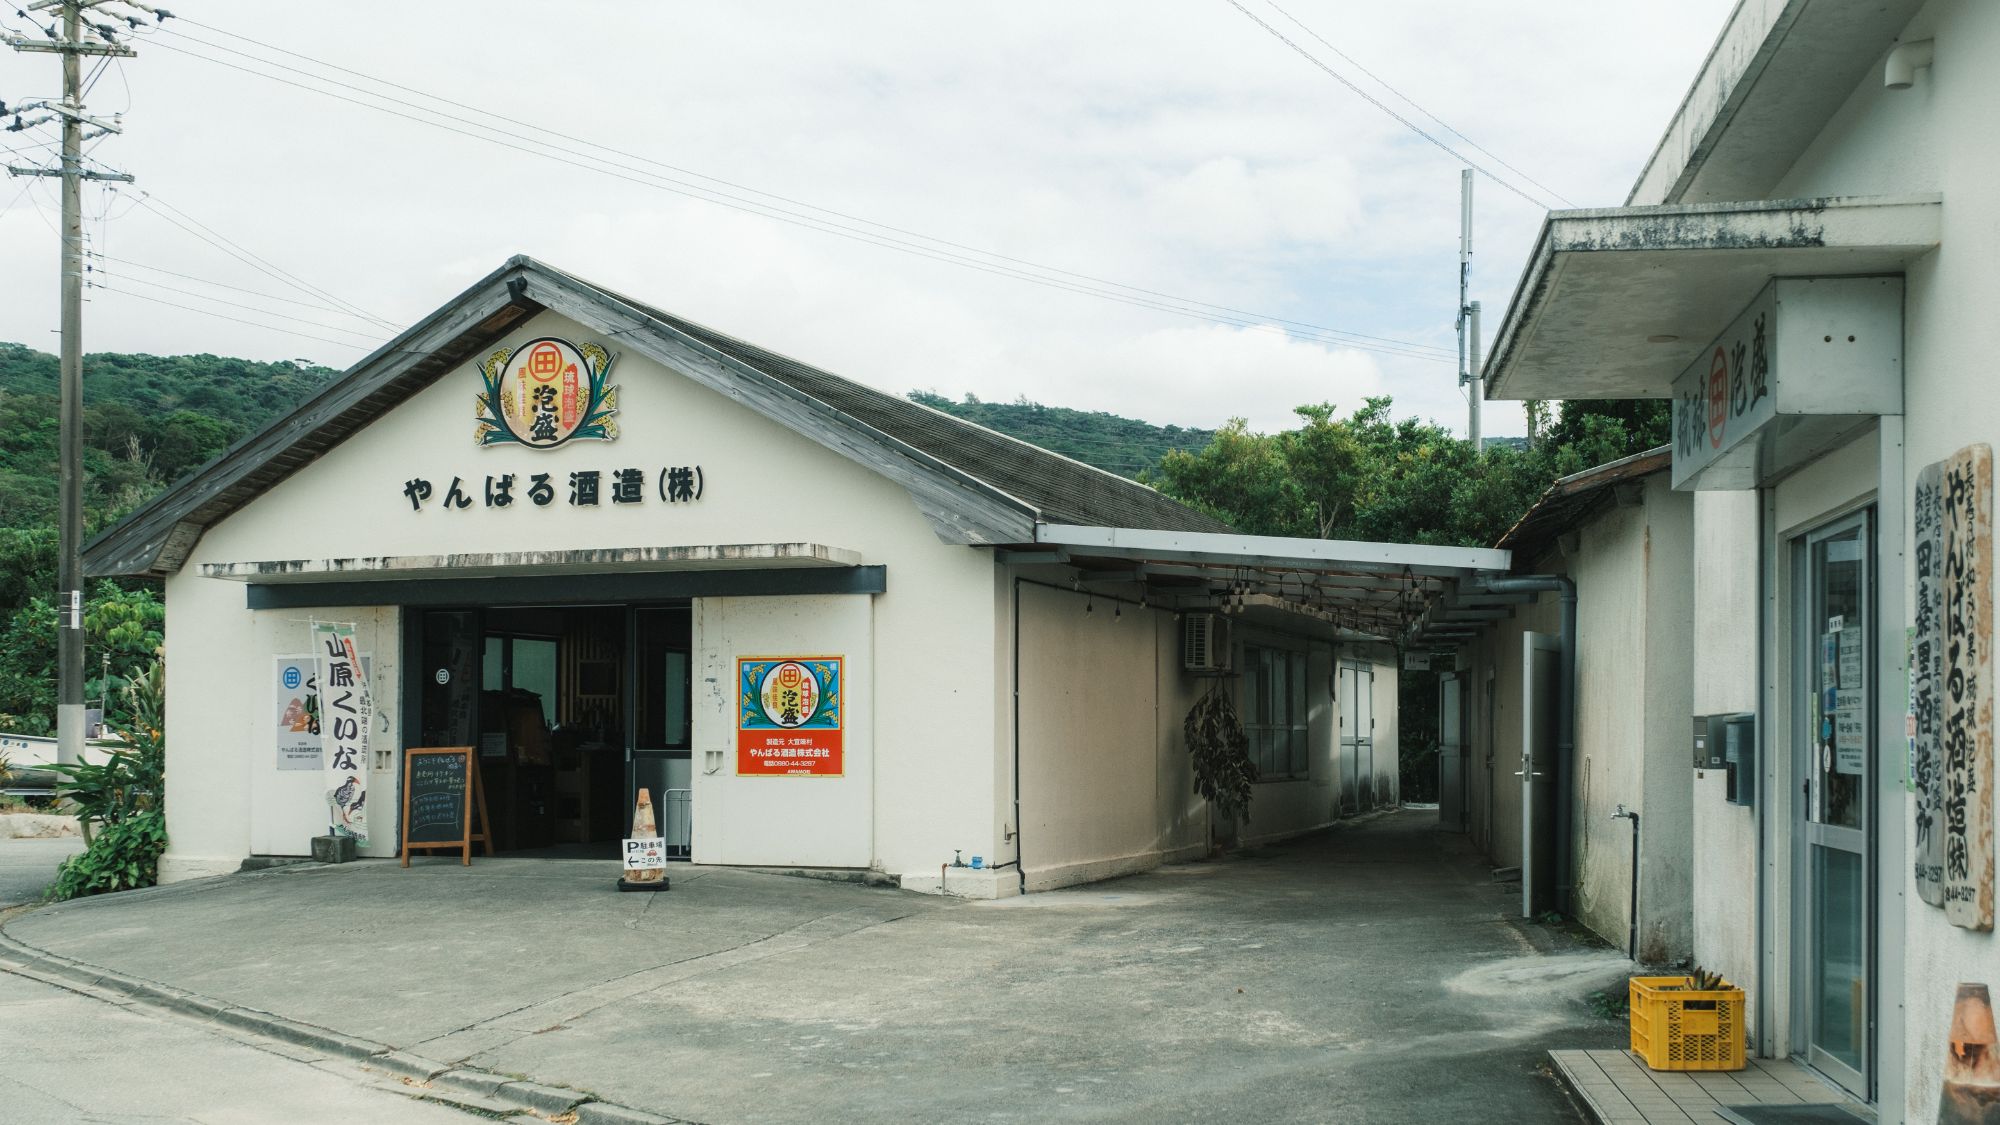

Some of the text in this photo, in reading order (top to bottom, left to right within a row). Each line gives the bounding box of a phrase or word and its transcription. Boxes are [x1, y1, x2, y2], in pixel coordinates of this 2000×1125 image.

[534, 351, 556, 373] 田
[529, 385, 560, 442] 泡盛
[325, 633, 358, 771] 山原くいな
[781, 690, 800, 725] 泡盛
[750, 748, 830, 758] やんばる酒造株式会社
[627, 841, 663, 853] P 駐車場
[641, 856, 663, 864] この先
